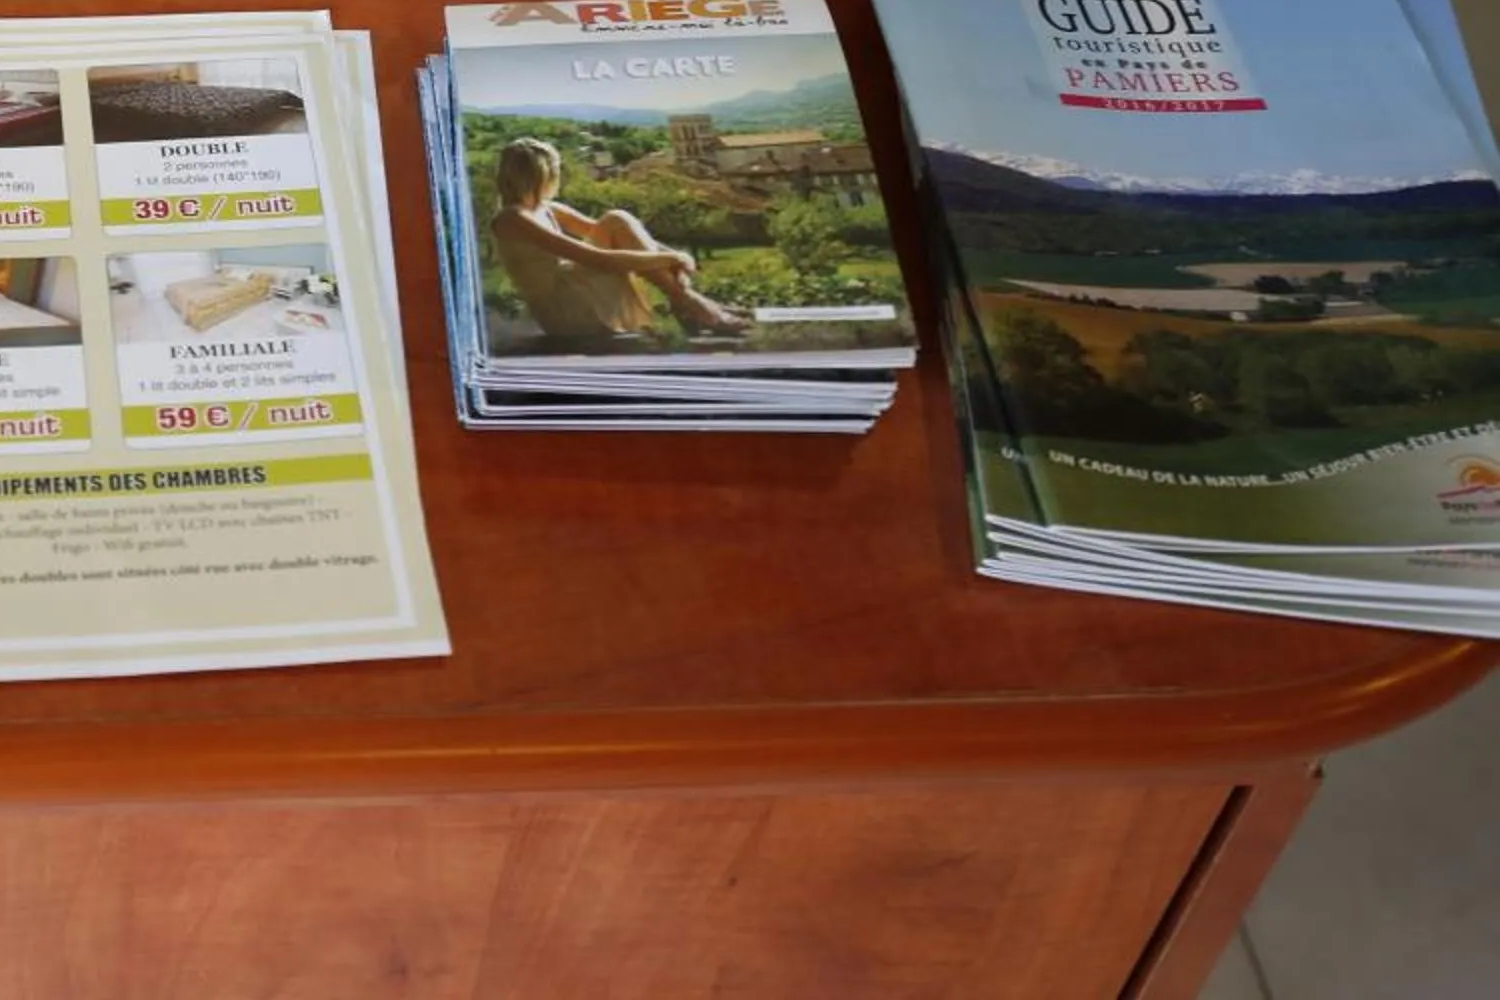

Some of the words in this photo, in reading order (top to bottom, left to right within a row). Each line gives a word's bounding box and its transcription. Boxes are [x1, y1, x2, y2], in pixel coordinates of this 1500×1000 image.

[1050, 37, 1222, 58] touristique
[572, 59, 614, 81] LA
[624, 54, 737, 78] CARTE
[1065, 67, 1240, 93] PAMIERS
[161, 141, 249, 158] DOUBLE
[163, 162, 173, 172] 2
[175, 159, 248, 172] personnes
[162, 173, 209, 185] double
[135, 199, 170, 219] 39
[179, 199, 200, 217] €
[238, 193, 294, 215] nuit
[169, 339, 296, 359] FAMILIALE
[216, 360, 293, 374] personnes
[167, 379, 219, 391] double
[0, 415, 60, 436] nuit
[158, 407, 197, 430] 59
[206, 406, 229, 426] €
[269, 401, 331, 423] nuit
[1049, 450, 1076, 466] UN
[1078, 457, 1150, 481] CADEAU
[1152, 470, 1175, 485] DE
[1178, 473, 1202, 486] LA
[109, 471, 147, 492] DES
[152, 466, 267, 489] CHAMBRES
